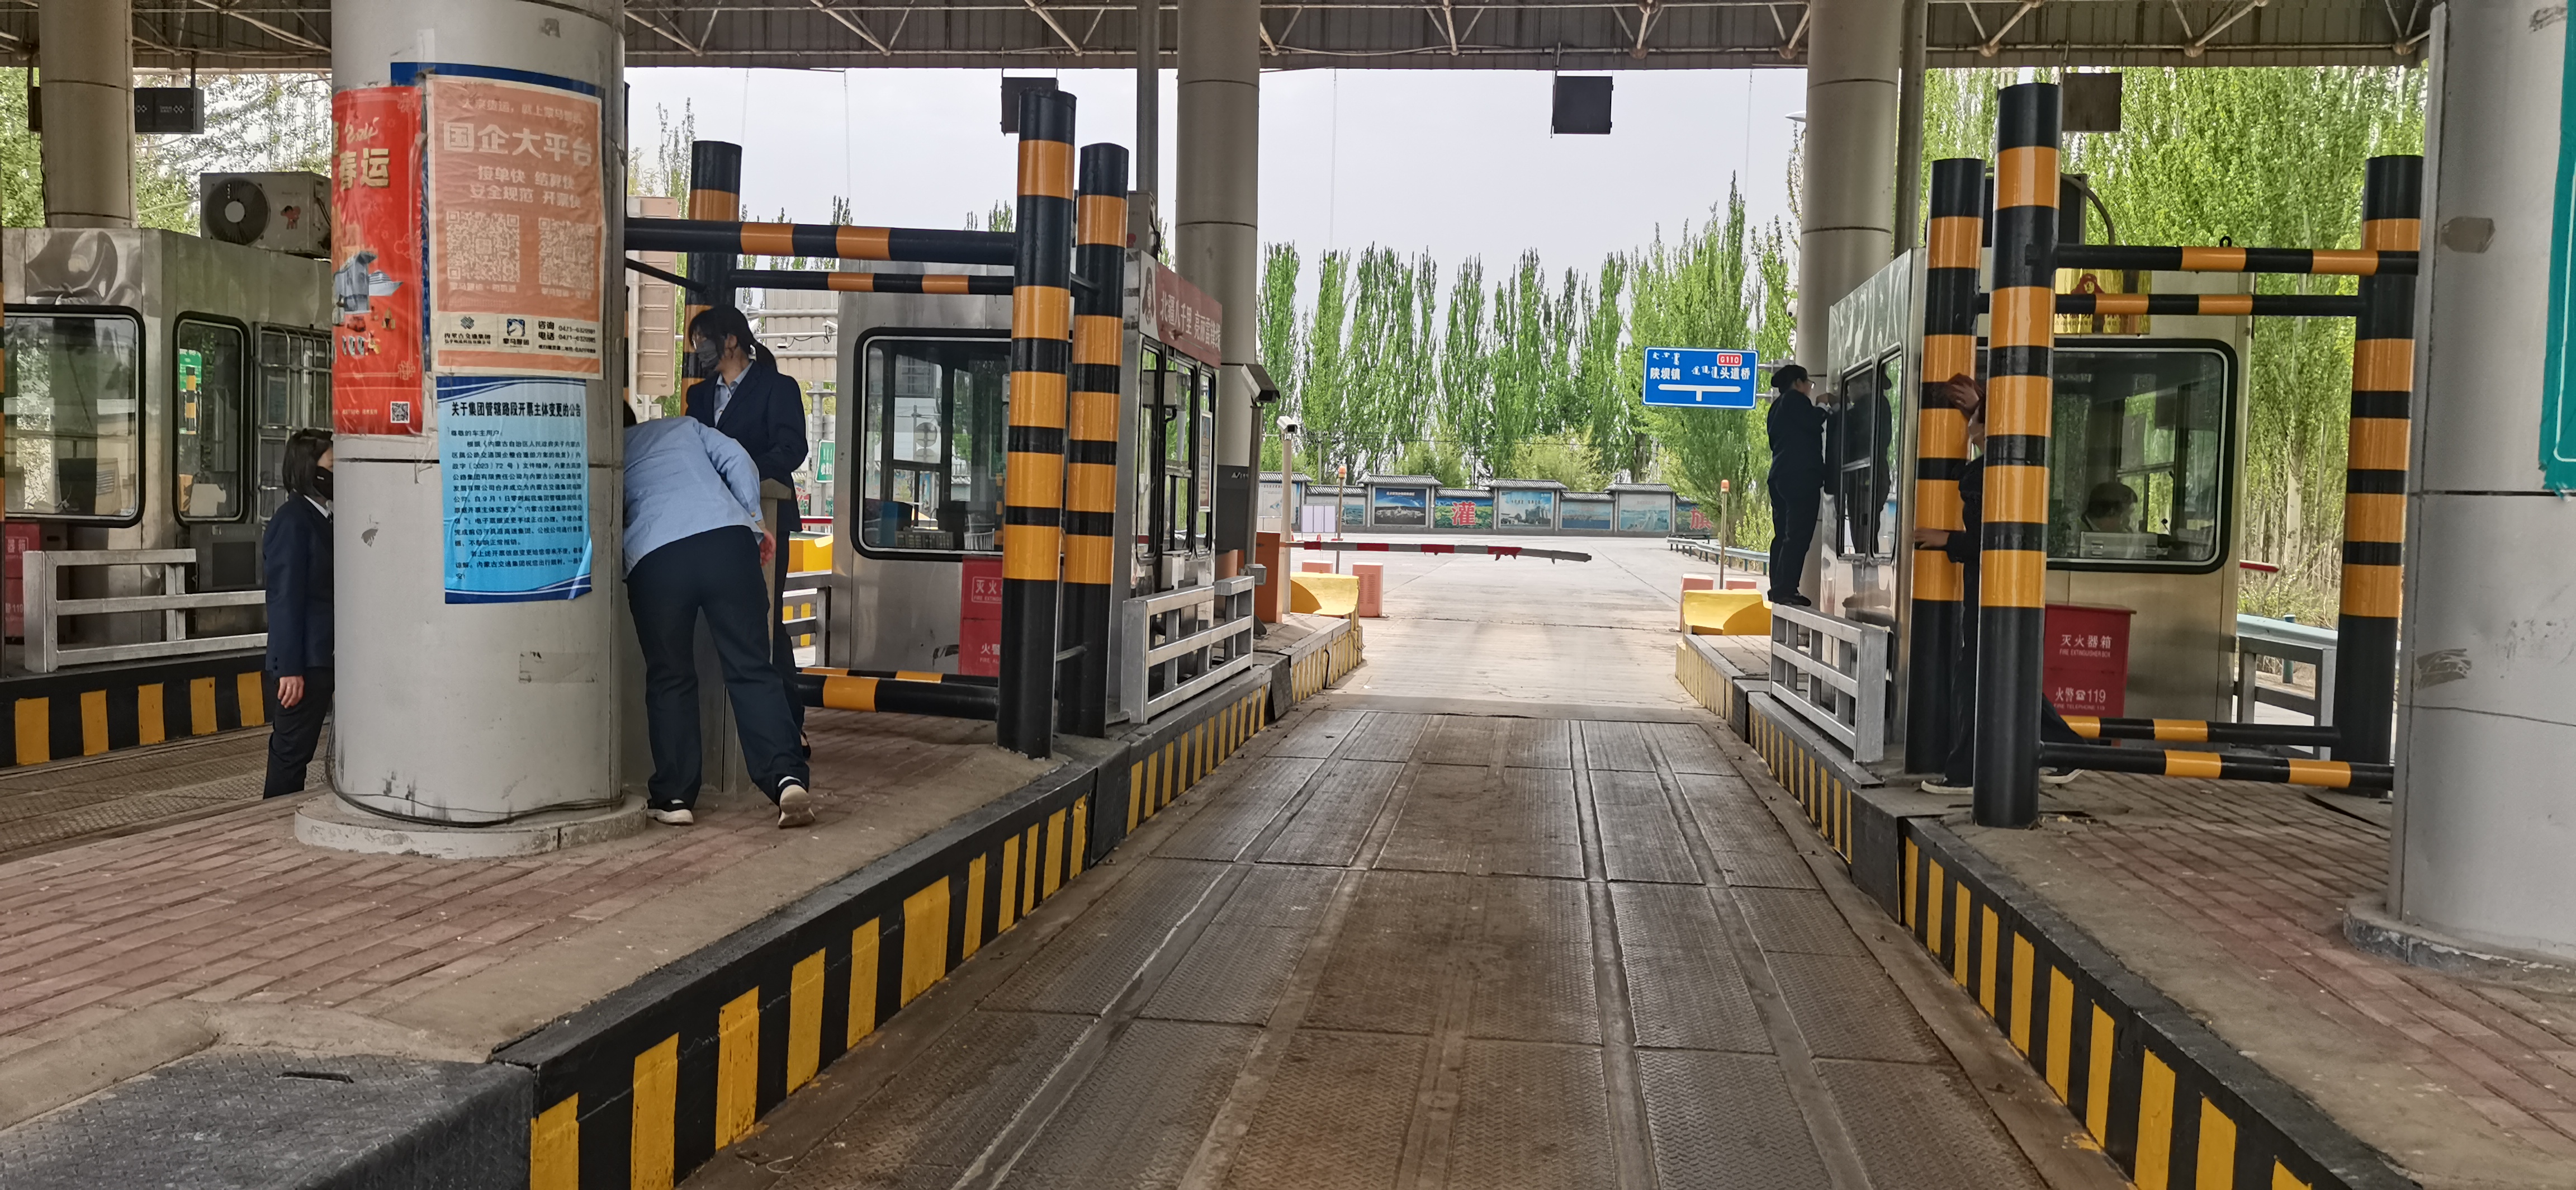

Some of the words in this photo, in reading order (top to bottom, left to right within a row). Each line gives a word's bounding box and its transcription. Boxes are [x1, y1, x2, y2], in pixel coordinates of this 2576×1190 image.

[444, 121, 593, 167] 国企大平台
[339, 148, 390, 192] 春运
[470, 184, 534, 203] 安全规范
[1650, 367, 1680, 380] 陕坝镇
[1720, 367, 1750, 380] 头道桥
[452, 402, 581, 417] 关于集团管辖路段开票主体变更的公告
[1451, 500, 1476, 526] 灌
[975, 579, 1002, 594] 灭火
[2060, 634, 2112, 649] 灭火器箱
[2087, 688, 2106, 703] 119
